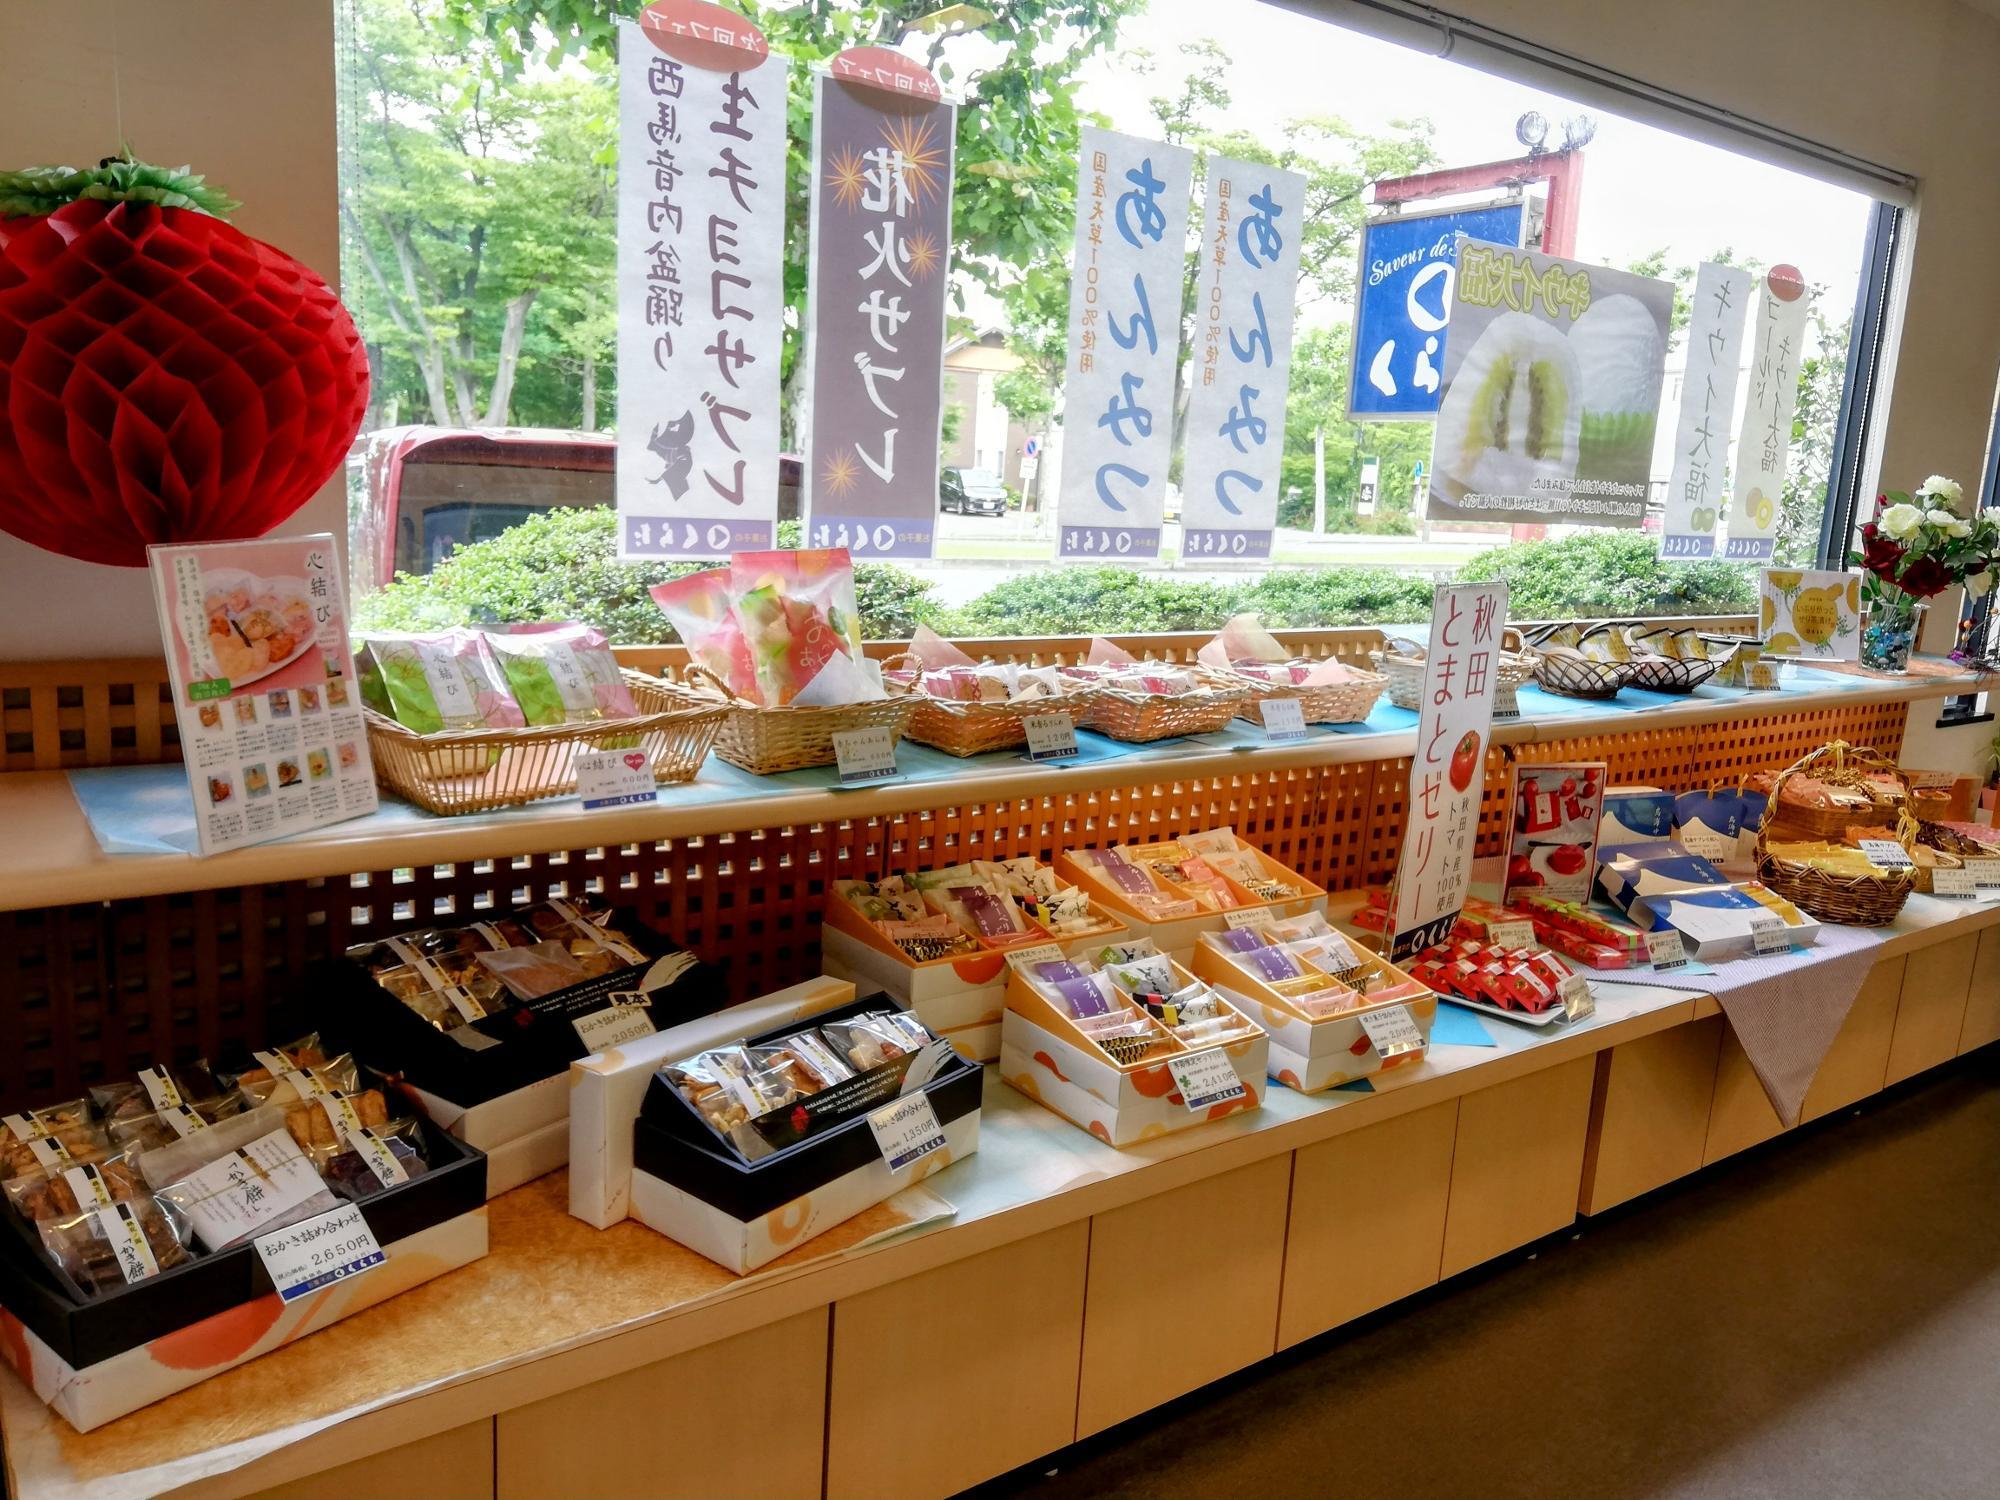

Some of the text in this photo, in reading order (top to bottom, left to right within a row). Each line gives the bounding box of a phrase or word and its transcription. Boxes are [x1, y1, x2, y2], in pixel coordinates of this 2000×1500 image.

[1369, 247, 1426, 287] Saveur
[1430, 234, 1448, 259] de
[1369, 335, 1441, 397] くら
[306, 552, 331, 624] 心結び
[1465, 594, 1497, 699] 秋田
[1413, 594, 1463, 920] とまとゼリー
[1436, 875, 1463, 894] 100%
[613, 992, 648, 1006] 見本
[264, 1211, 361, 1257] おかき詰め合わせ
[311, 1233, 371, 1266] 2,650円
